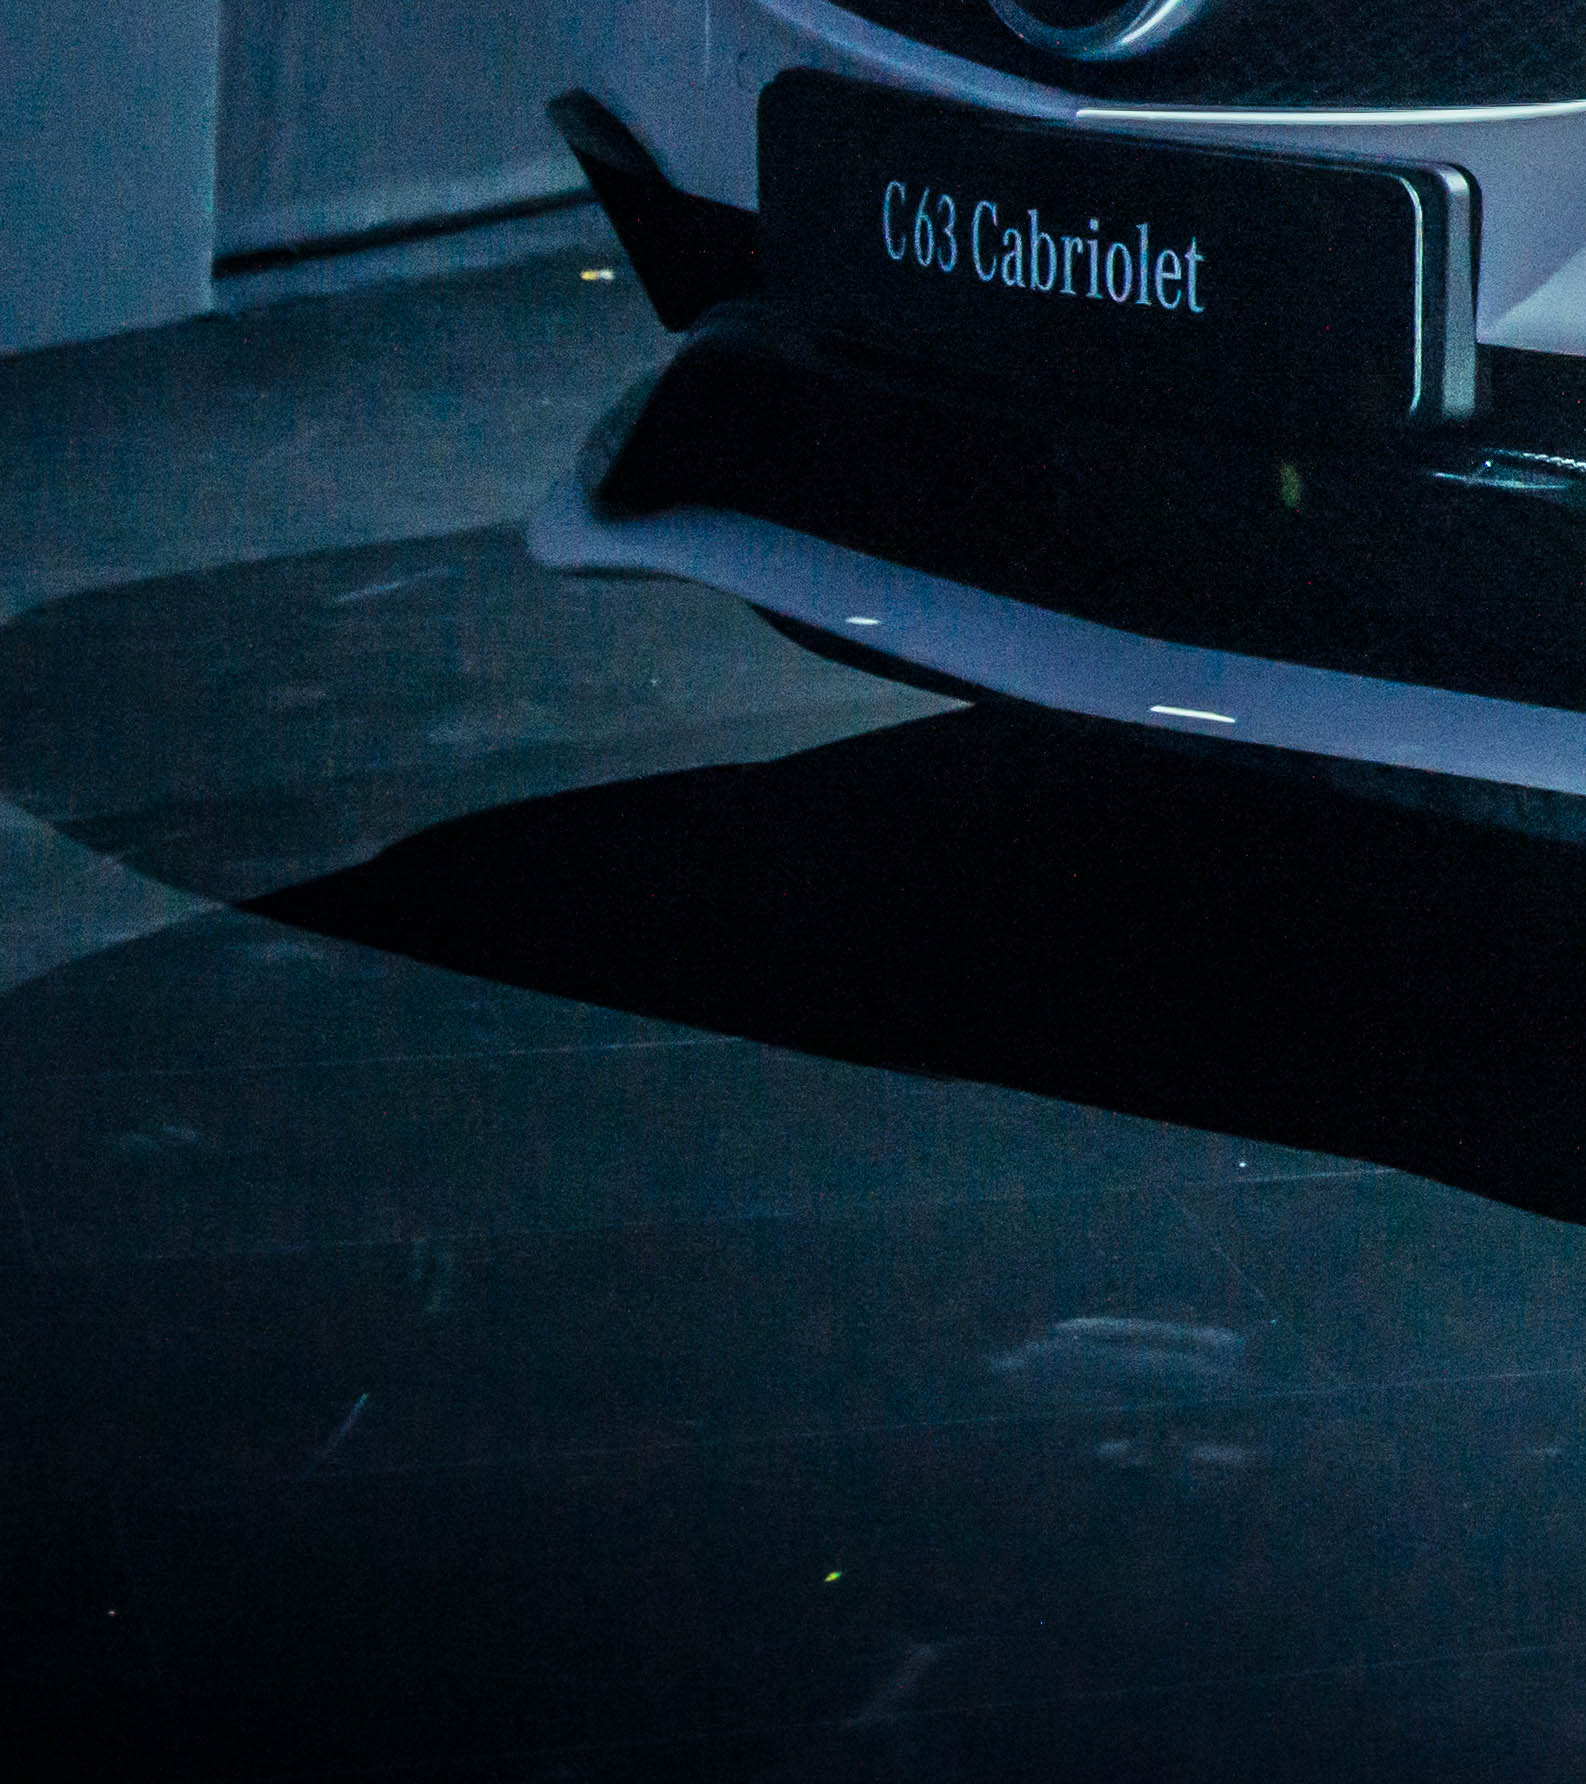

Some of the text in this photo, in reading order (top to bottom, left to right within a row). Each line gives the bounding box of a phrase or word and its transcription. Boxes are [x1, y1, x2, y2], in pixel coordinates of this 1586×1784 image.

[881, 180, 1205, 315] C 63 Cabriolet
